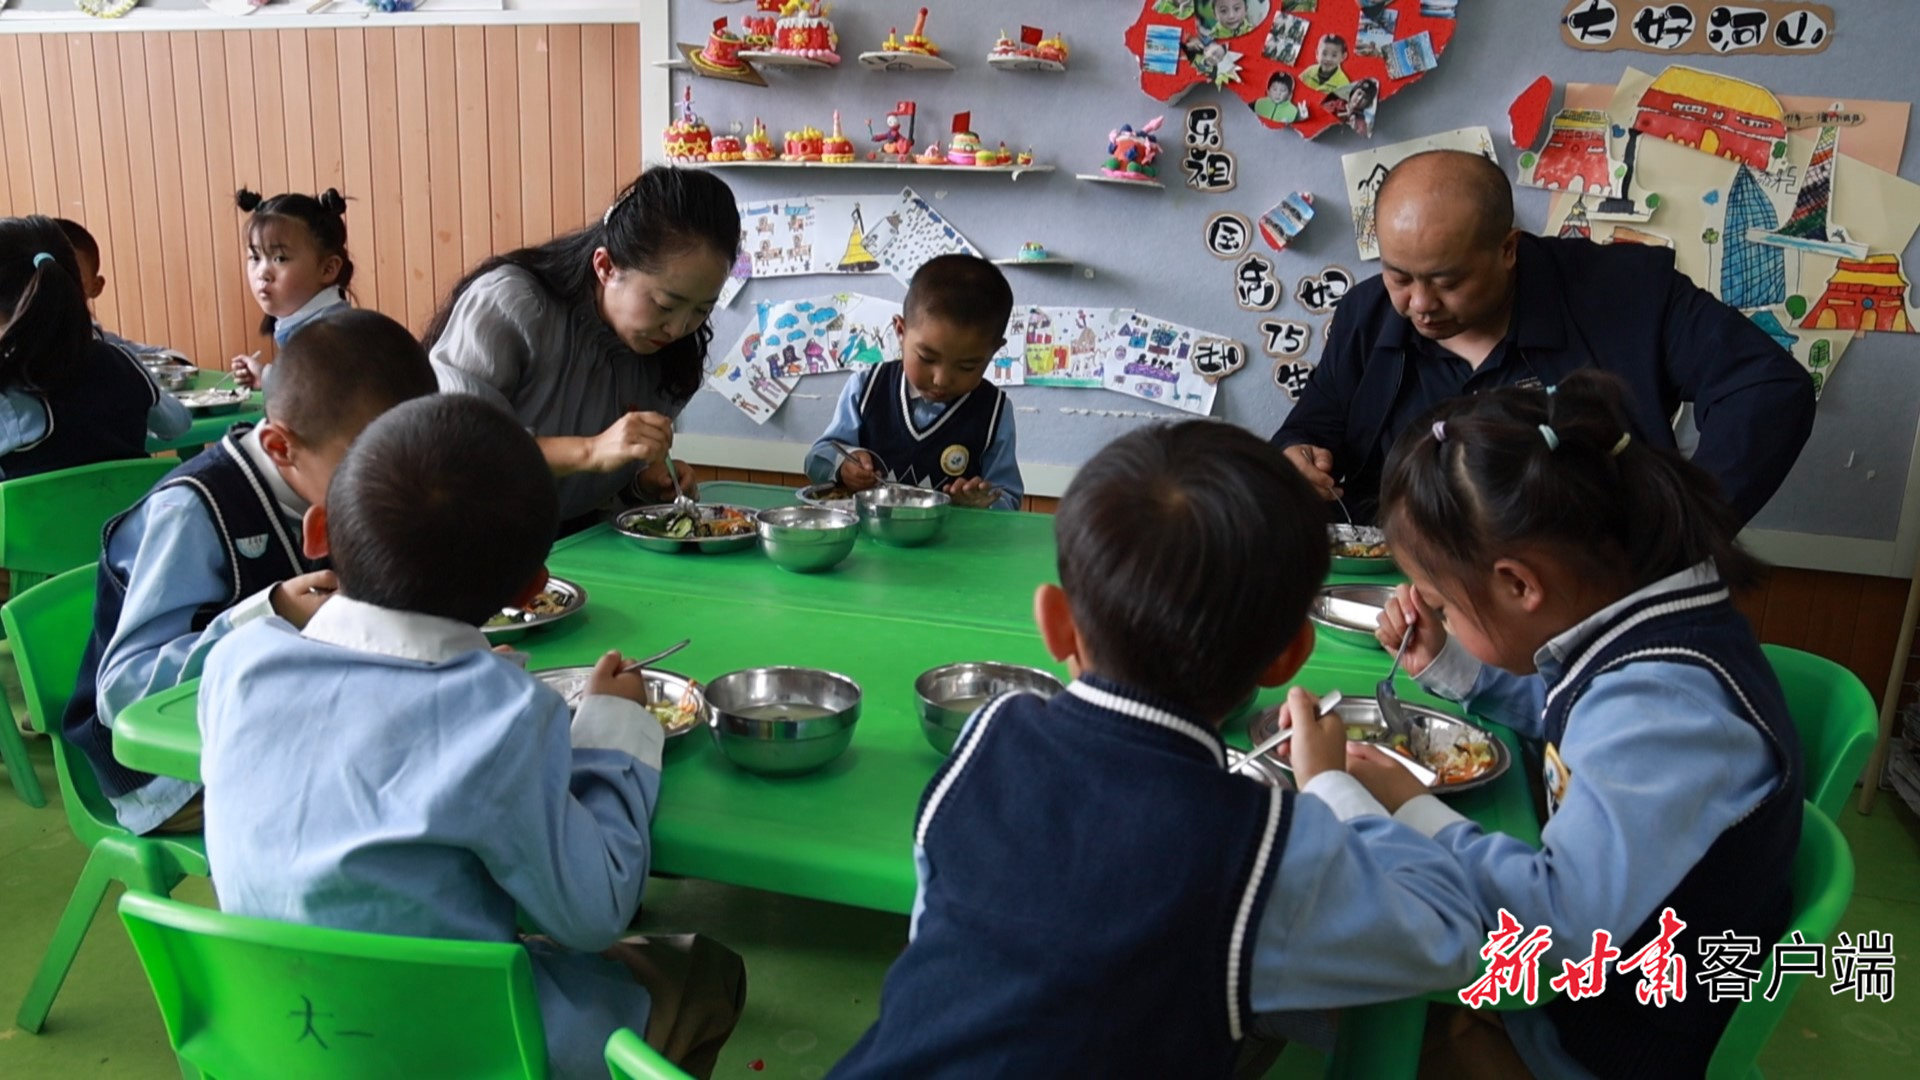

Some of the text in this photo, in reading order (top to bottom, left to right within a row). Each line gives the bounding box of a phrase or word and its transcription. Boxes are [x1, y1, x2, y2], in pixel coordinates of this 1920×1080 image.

[1569, 0, 1824, 51] 大好河山
[1265, 323, 1304, 352] 75
